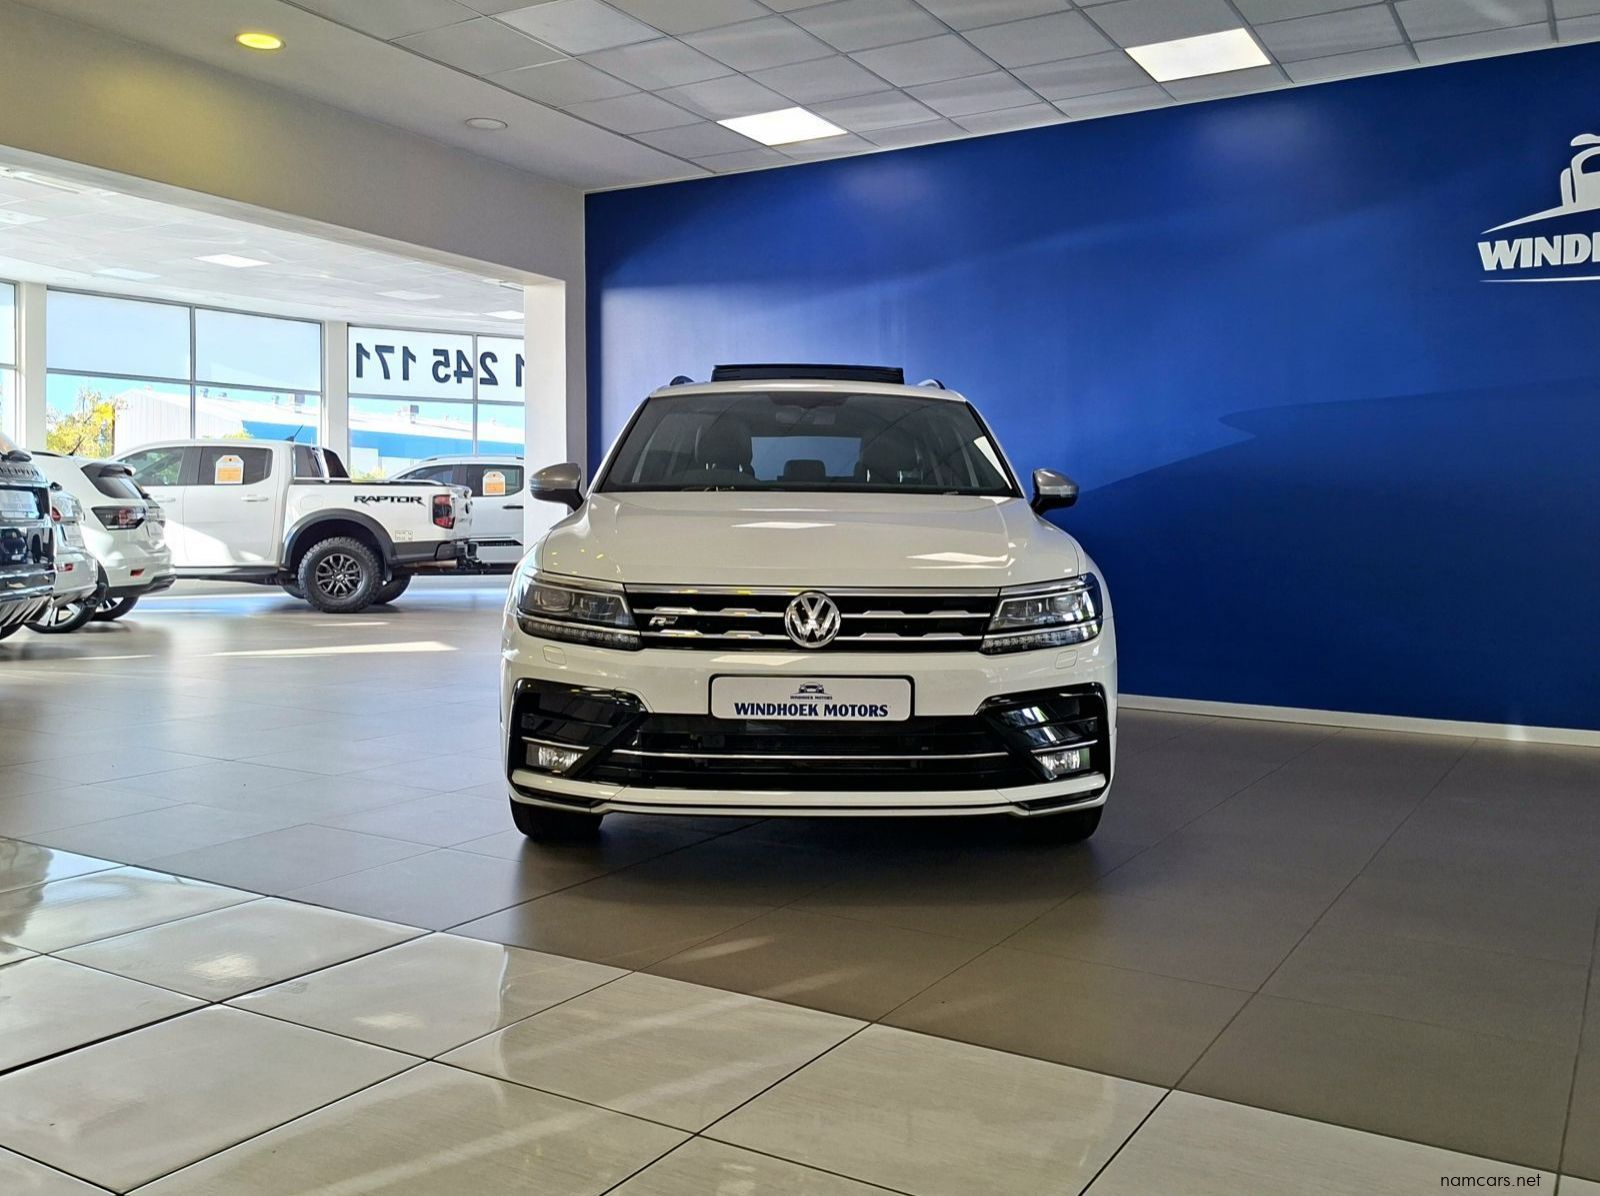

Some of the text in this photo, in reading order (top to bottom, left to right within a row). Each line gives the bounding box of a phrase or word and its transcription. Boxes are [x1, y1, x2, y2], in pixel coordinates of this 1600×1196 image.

[354, 495, 425, 506] RAPTOR
[734, 702, 888, 717] WINDHOEK MOTORS
